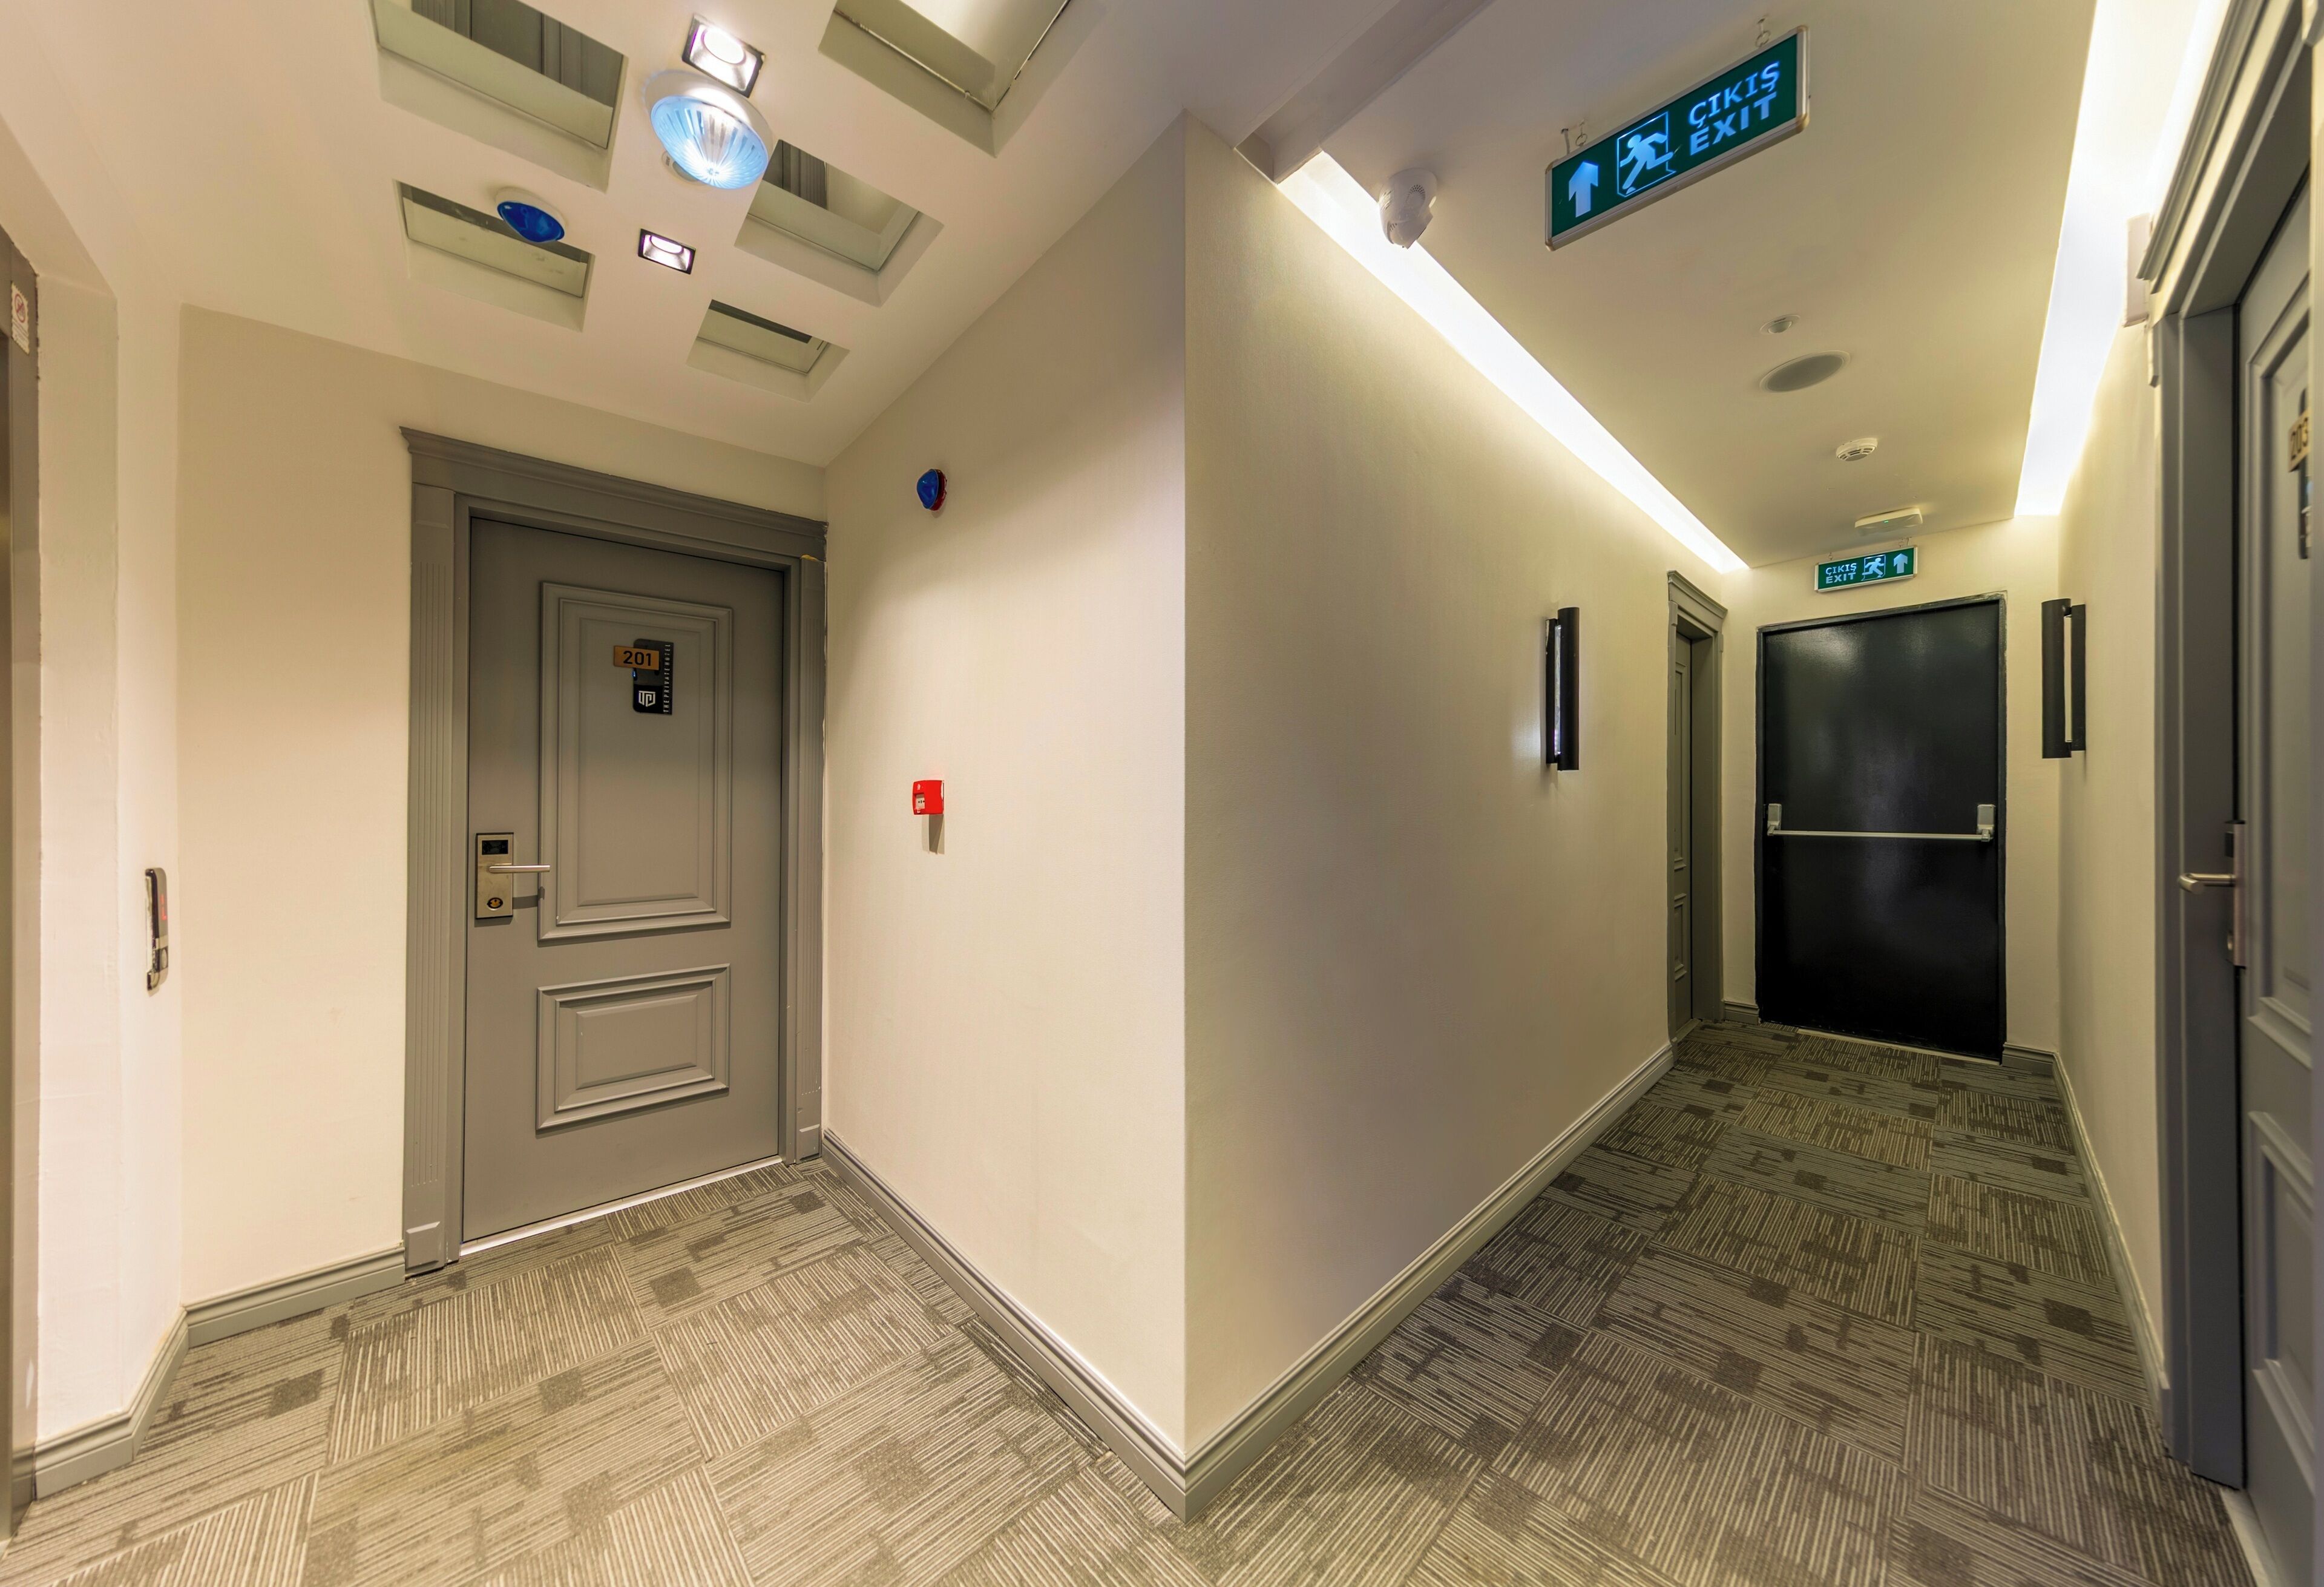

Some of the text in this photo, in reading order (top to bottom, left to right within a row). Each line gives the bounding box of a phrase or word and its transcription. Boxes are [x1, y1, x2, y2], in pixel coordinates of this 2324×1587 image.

[1688, 61, 1780, 128] ÇIKIŞ
[1689, 91, 1777, 156] EXIT
[1825, 563, 1857, 576] ÇIKIŞ
[1825, 572, 1856, 584] EXIT
[623, 651, 651, 666] 201
